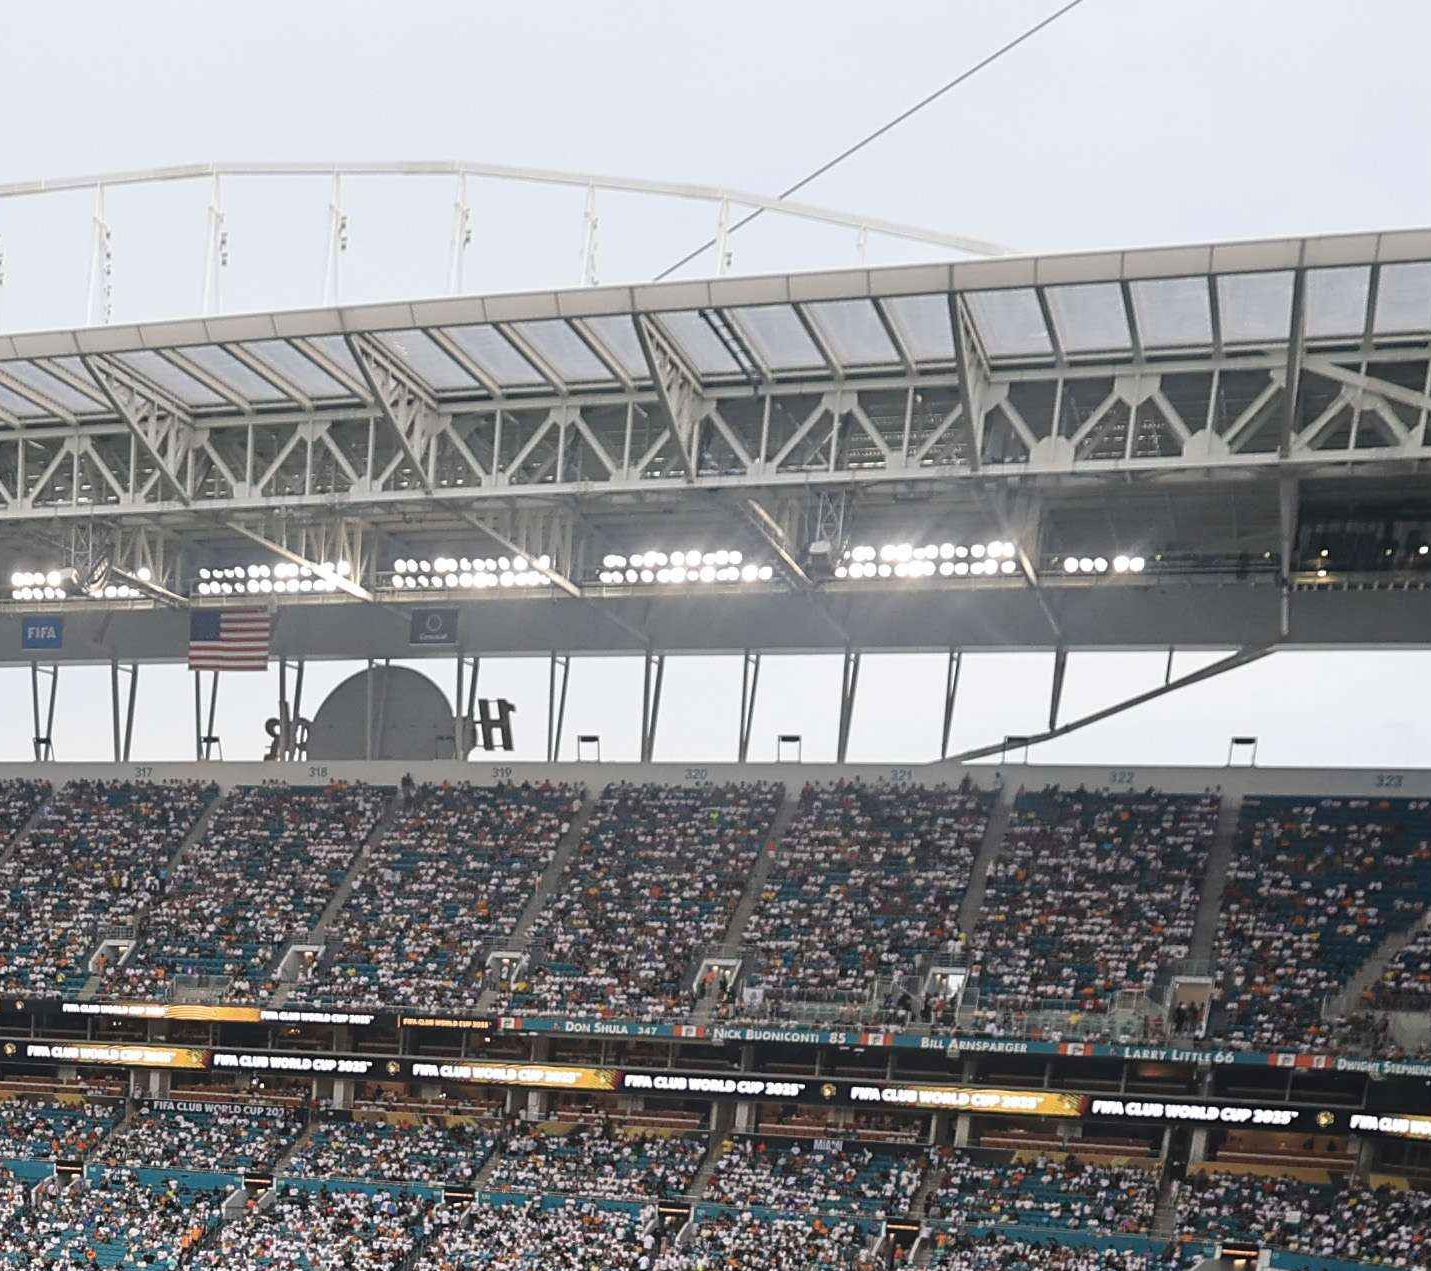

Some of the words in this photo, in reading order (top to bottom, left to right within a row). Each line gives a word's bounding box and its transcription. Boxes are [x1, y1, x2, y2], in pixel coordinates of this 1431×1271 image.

[27, 626, 57, 640] FIFA
[829, 1032, 846, 1044] 85
[214, 1055, 241, 1067] FIFA
[242, 1055, 267, 1068] CLUB
[269, 1057, 311, 1070] WORLD
[313, 1059, 336, 1071] CUP
[1214, 1051, 1234, 1064] 66
[625, 1074, 653, 1088] FIFA
[654, 1076, 687, 1090] CLUB
[689, 1079, 735, 1093] WORLD
[737, 1081, 764, 1094] CUP
